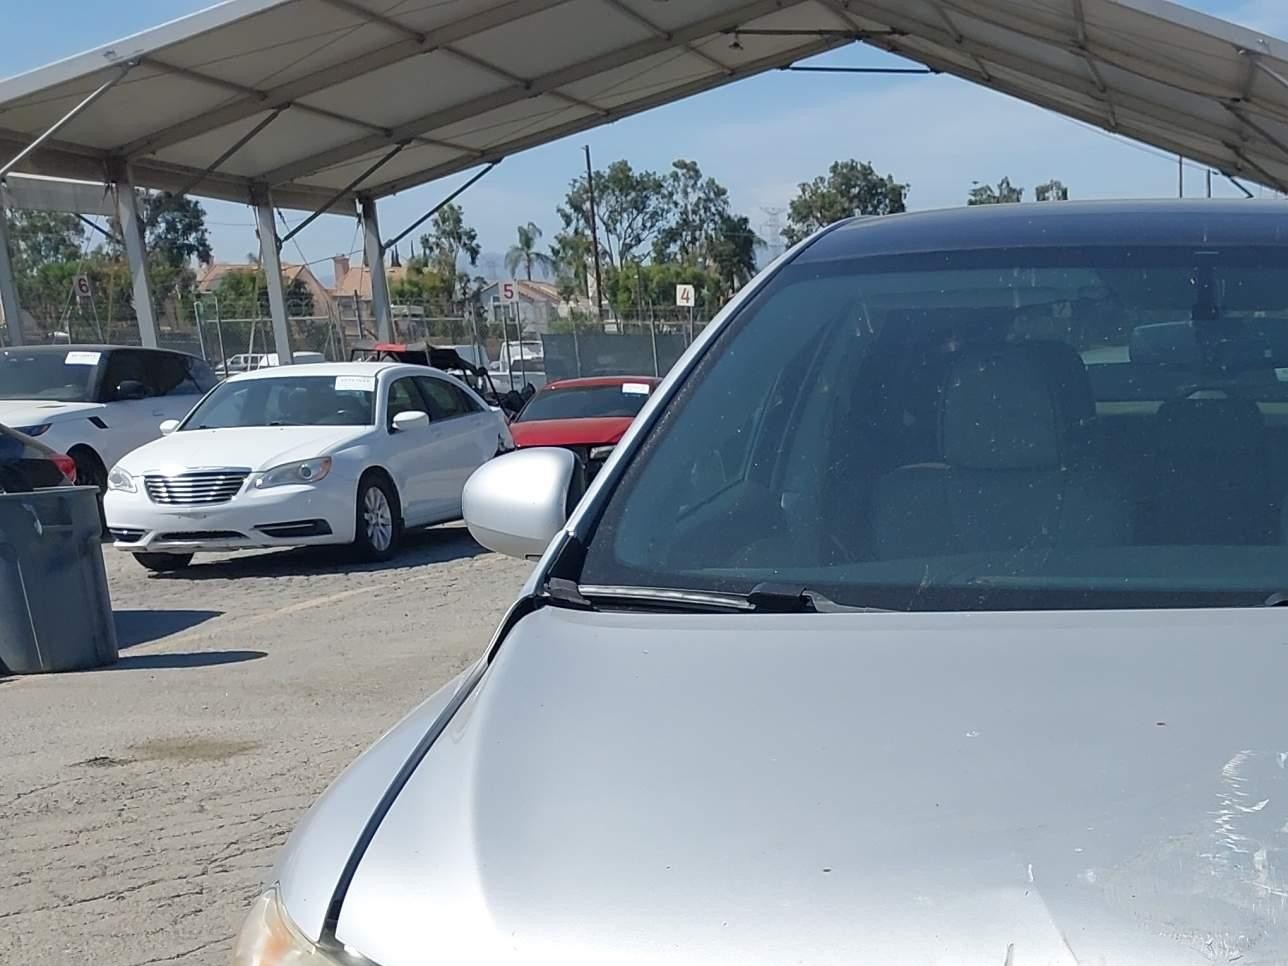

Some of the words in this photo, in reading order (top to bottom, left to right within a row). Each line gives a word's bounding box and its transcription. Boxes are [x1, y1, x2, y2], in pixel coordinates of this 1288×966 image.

[79, 278, 89, 294] 6
[503, 283, 514, 299] 5
[680, 287, 690, 304] 4
